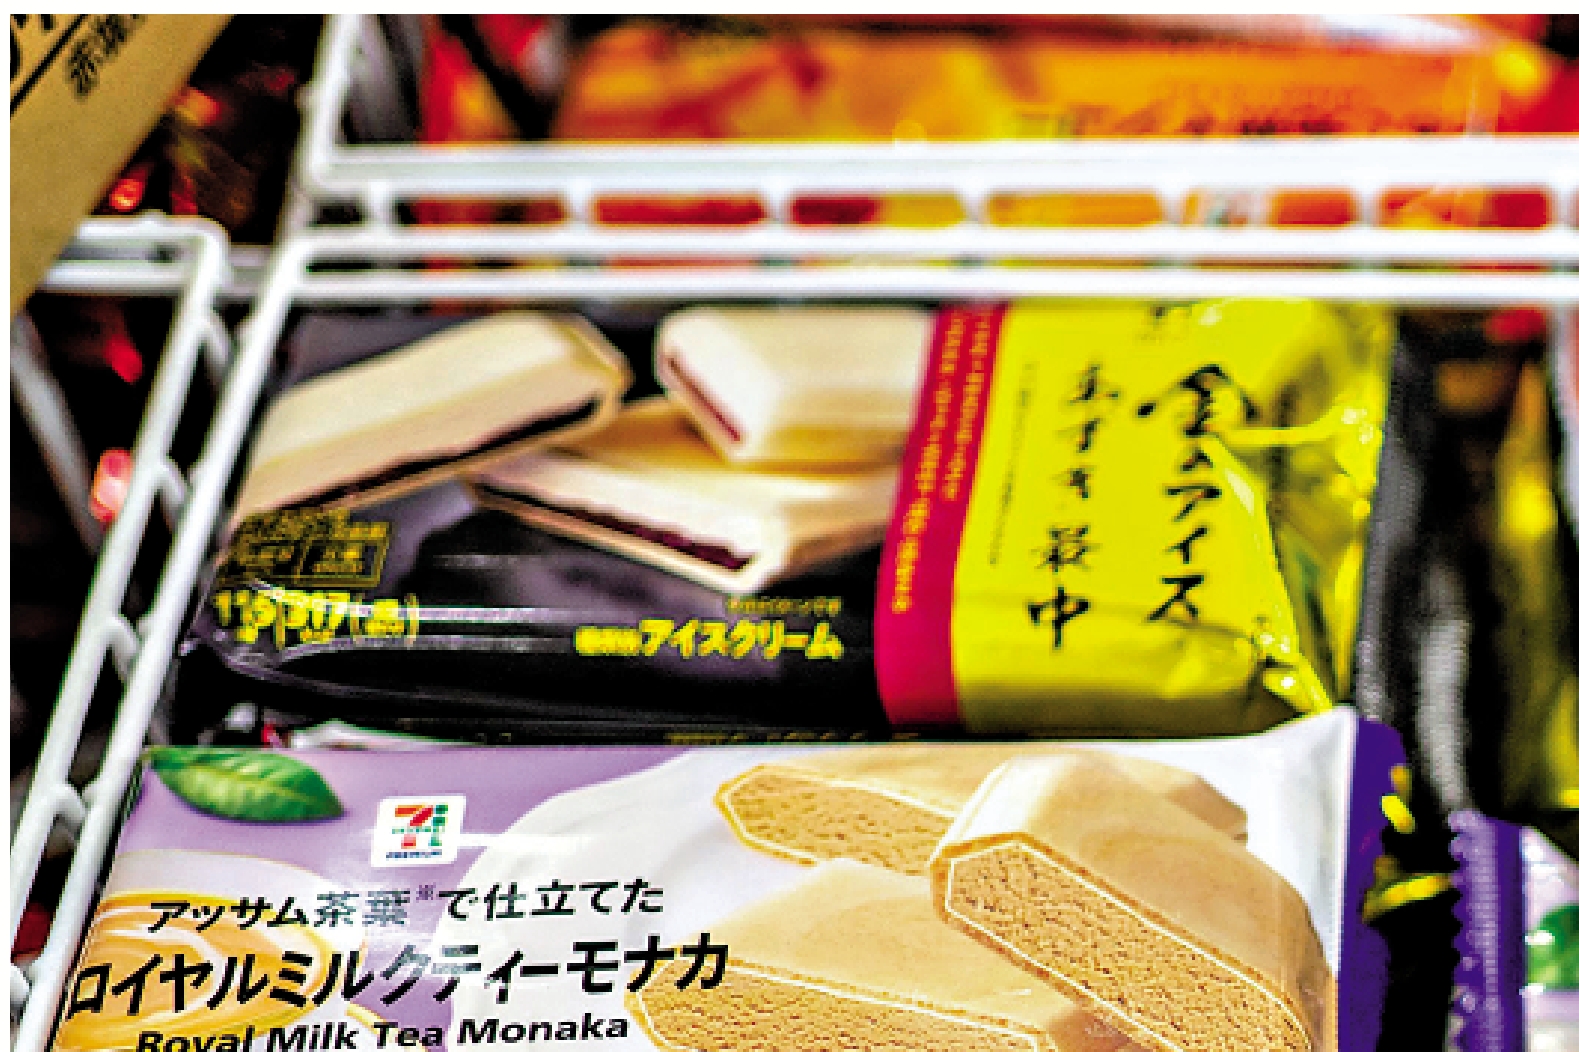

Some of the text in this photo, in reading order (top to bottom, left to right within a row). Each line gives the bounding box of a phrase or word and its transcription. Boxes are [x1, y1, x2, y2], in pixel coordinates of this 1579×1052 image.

[65, 932, 730, 1020] ロイヤルミルクティーモナカ
[266, 1020, 360, 1052] Milk
[374, 1020, 442, 1050] Tea
[458, 1013, 629, 1046] Monaka
